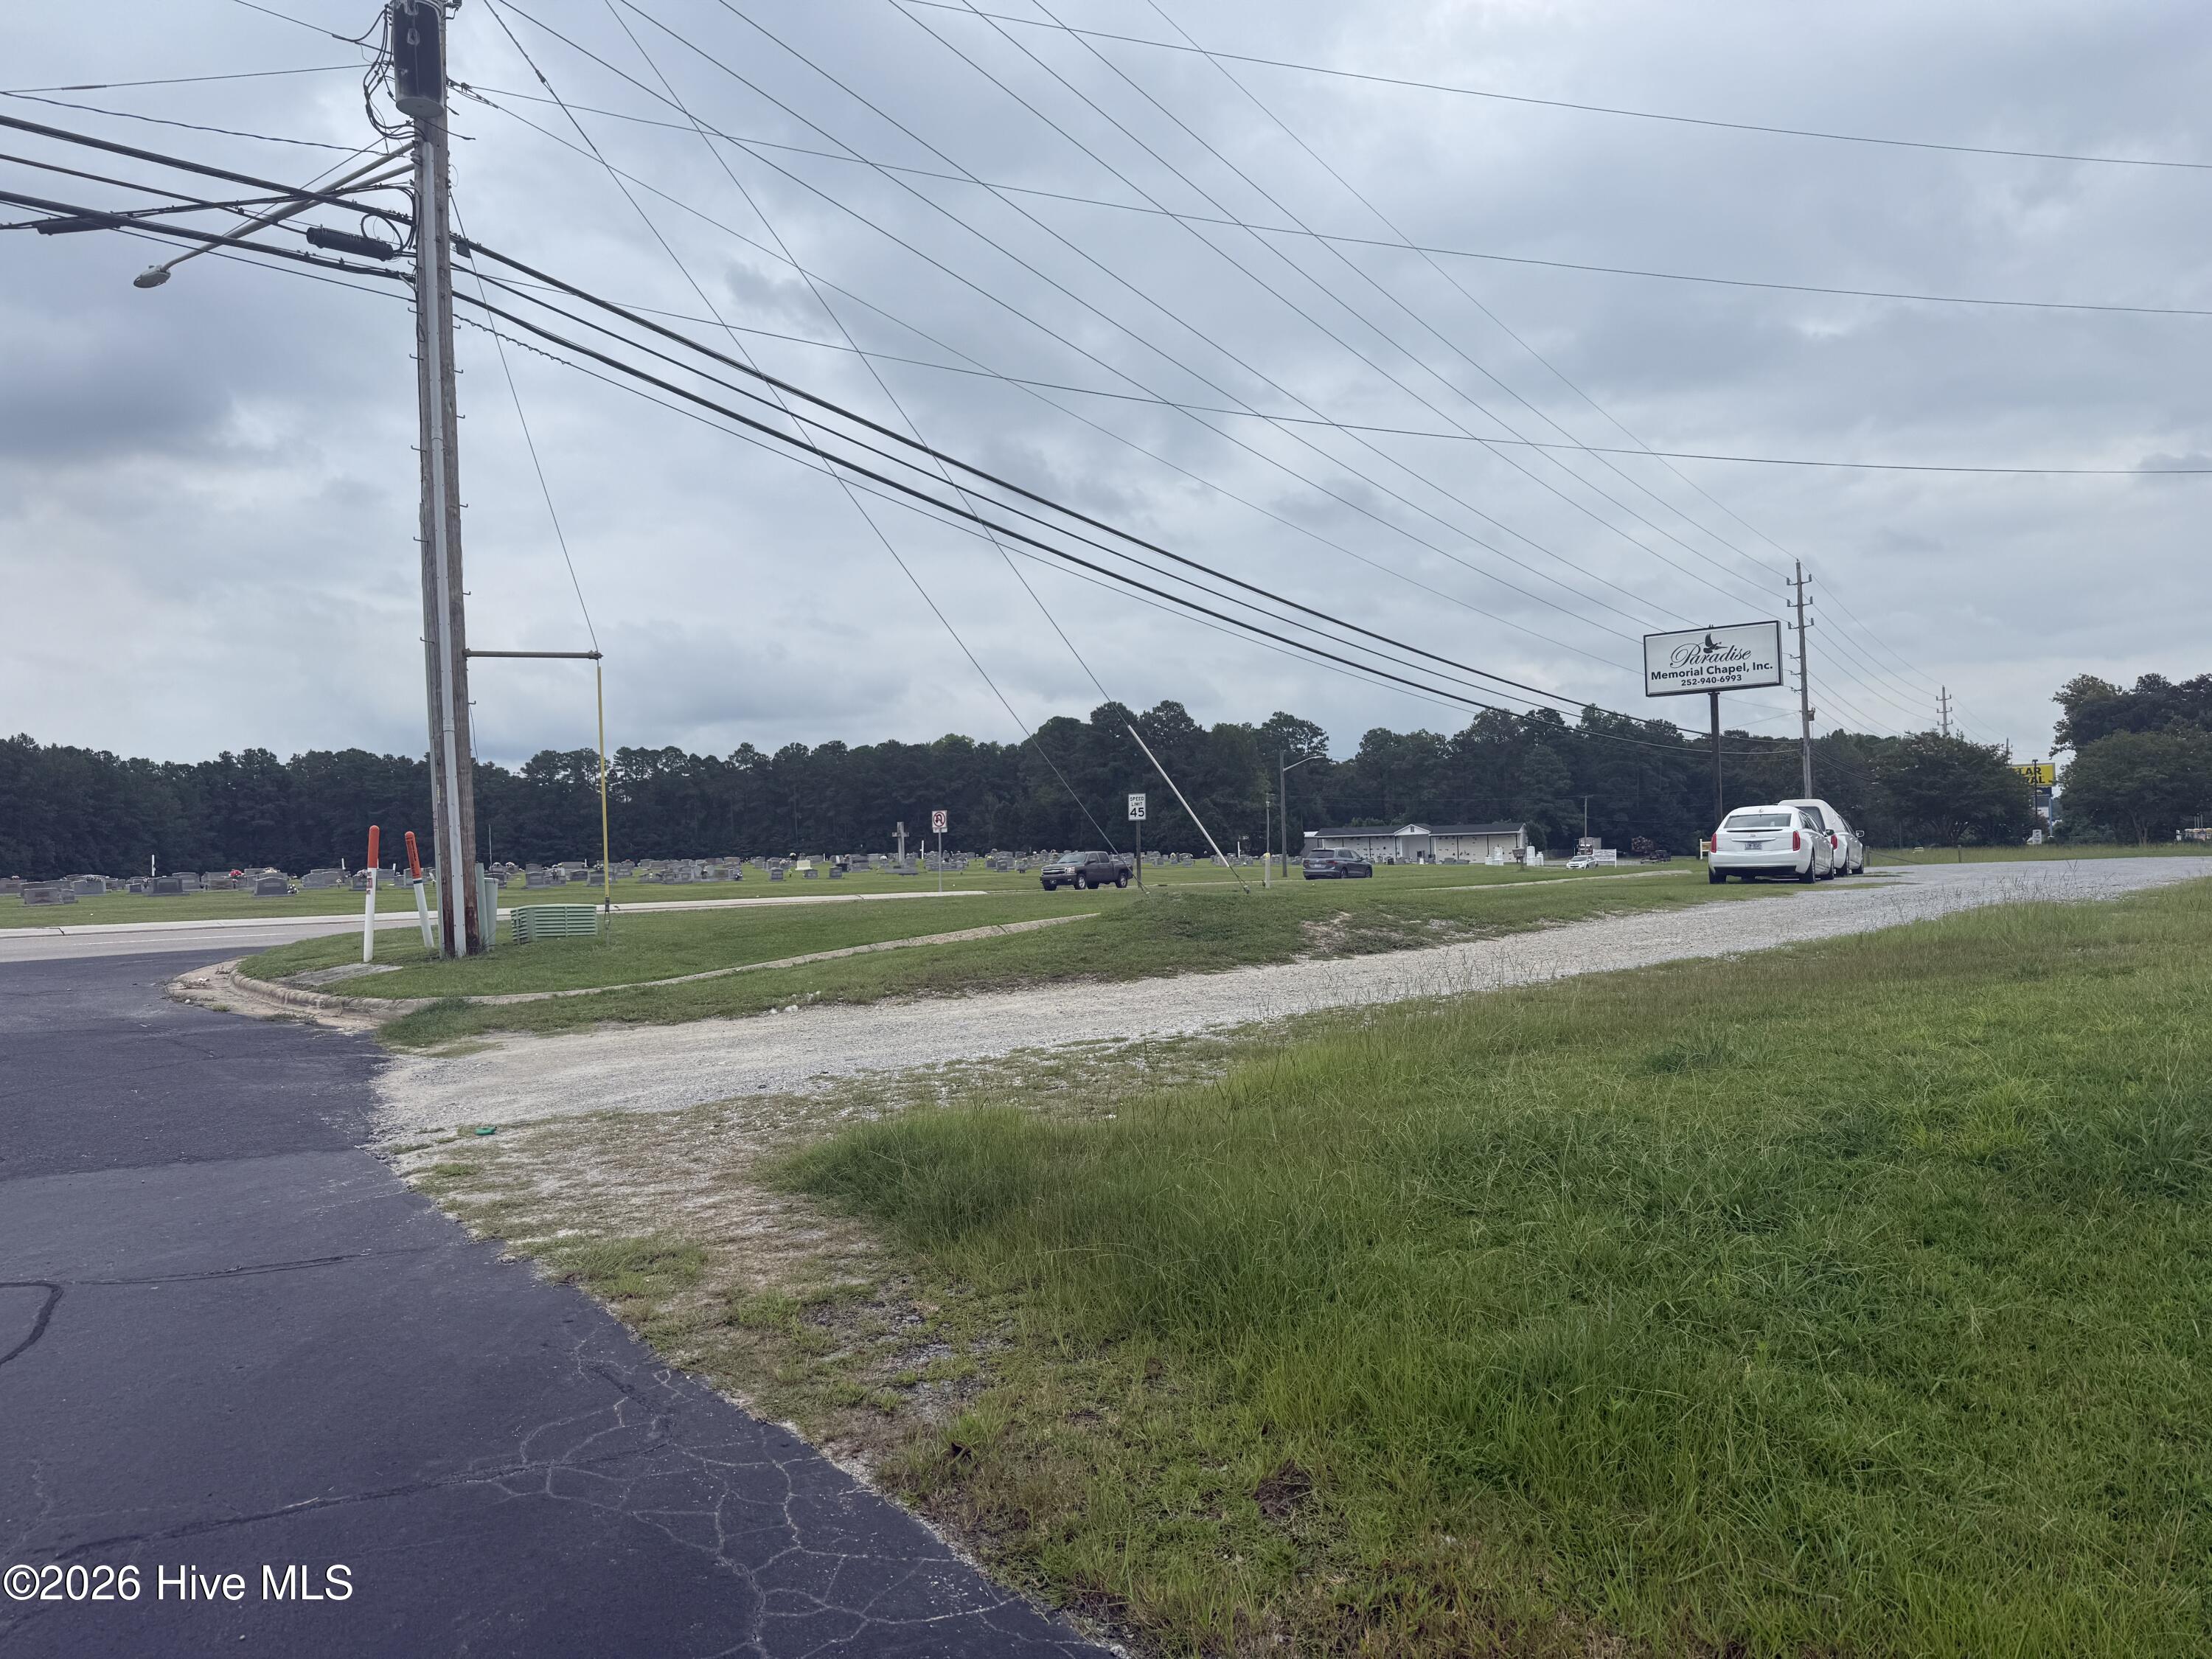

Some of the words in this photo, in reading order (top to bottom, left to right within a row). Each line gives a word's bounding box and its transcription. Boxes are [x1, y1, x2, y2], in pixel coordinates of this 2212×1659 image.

[1670, 642, 1751, 668] Paradise
[1651, 667, 1703, 680] Memorial
[1706, 662, 1750, 676] Chapel,
[1753, 661, 1773, 671] Inc.
[1681, 674, 1742, 686] 252-940-6993
[1130, 807, 1144, 818] 45
